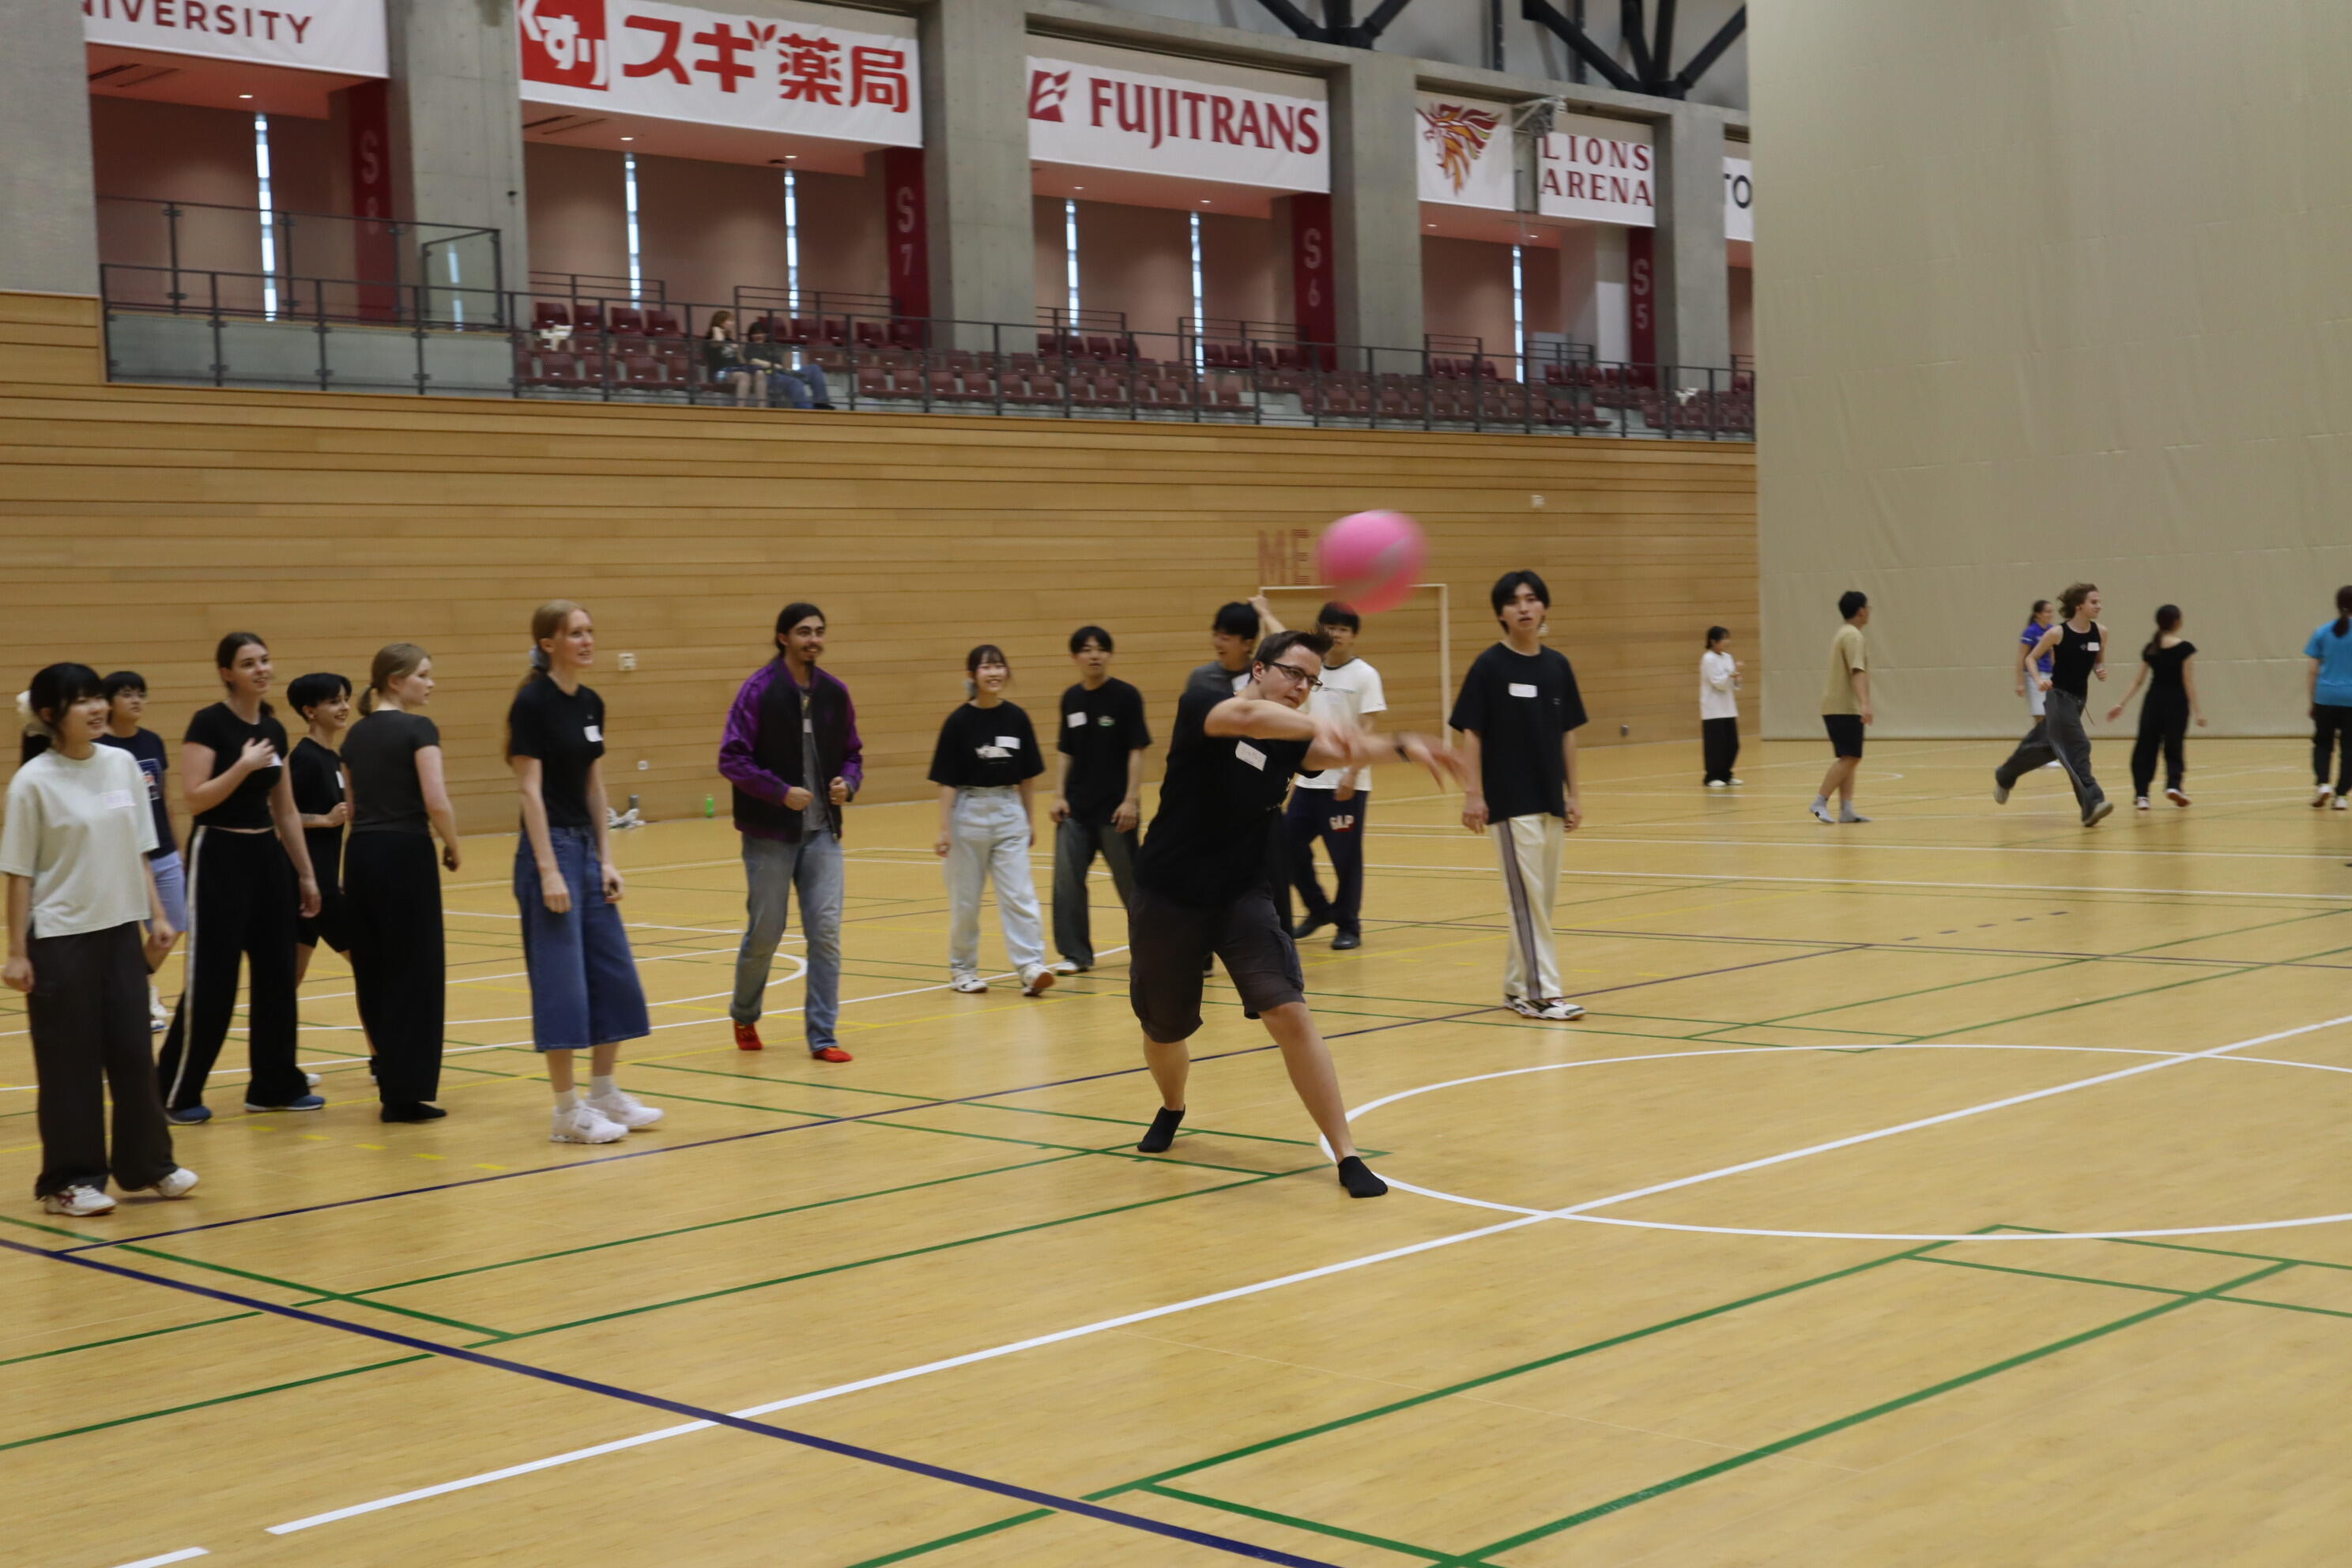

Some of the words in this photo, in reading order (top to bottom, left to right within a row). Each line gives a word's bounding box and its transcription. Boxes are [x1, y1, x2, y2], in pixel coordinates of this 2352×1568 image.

[622, 14, 909, 113] スギ薬局
[1089, 77, 1319, 155] FUJITRANS
[1543, 135, 1649, 172] LIONS
[1540, 168, 1653, 207] ARENA
[1257, 529, 1321, 586] ME
